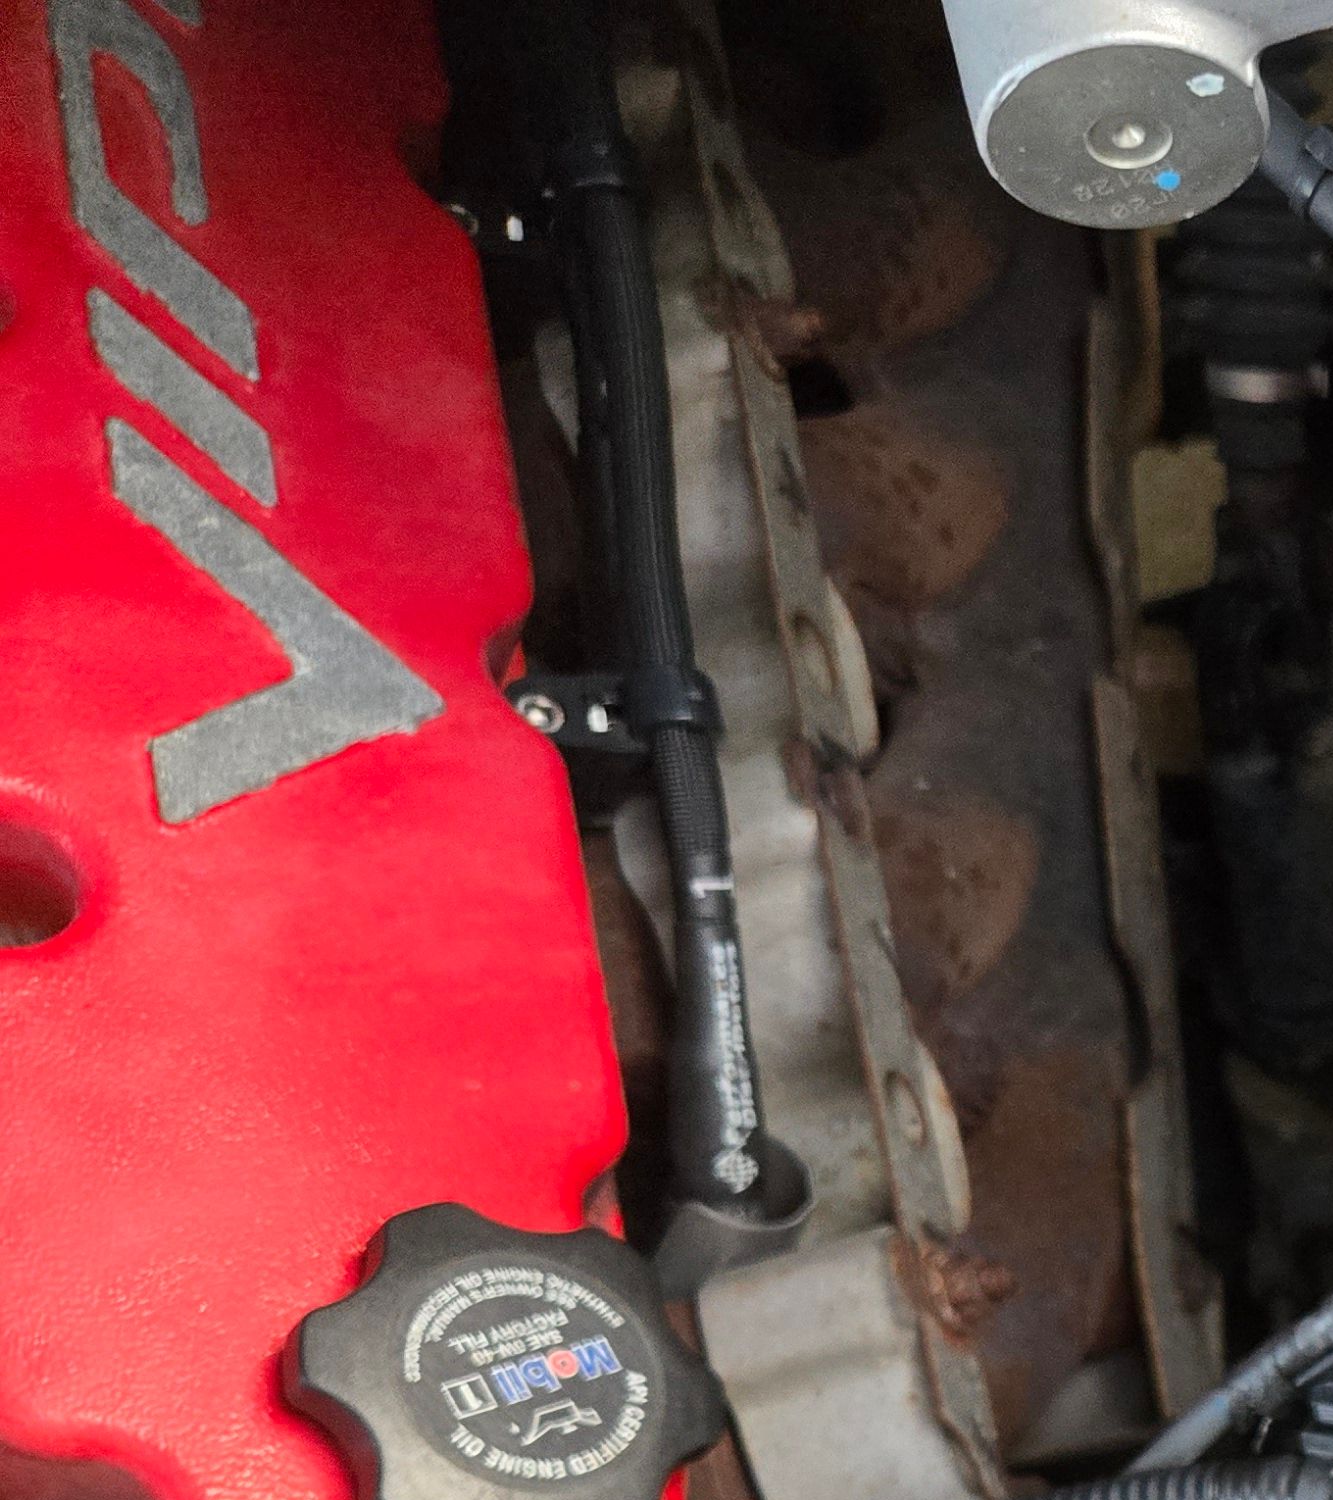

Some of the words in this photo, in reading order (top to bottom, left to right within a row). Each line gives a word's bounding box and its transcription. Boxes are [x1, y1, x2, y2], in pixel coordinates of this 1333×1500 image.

[44, 0, 446, 826] VIP
[453, 1270, 484, 1290] OIL
[447, 1330, 490, 1355] FILL
[489, 1307, 569, 1344] FACTORY
[524, 1327, 564, 1352] SAE
[490, 1333, 624, 1406] Mobil
[449, 1422, 486, 1457] OIL
[566, 1402, 646, 1477] CERTIFIED
[482, 1445, 568, 1481] ENGINE
